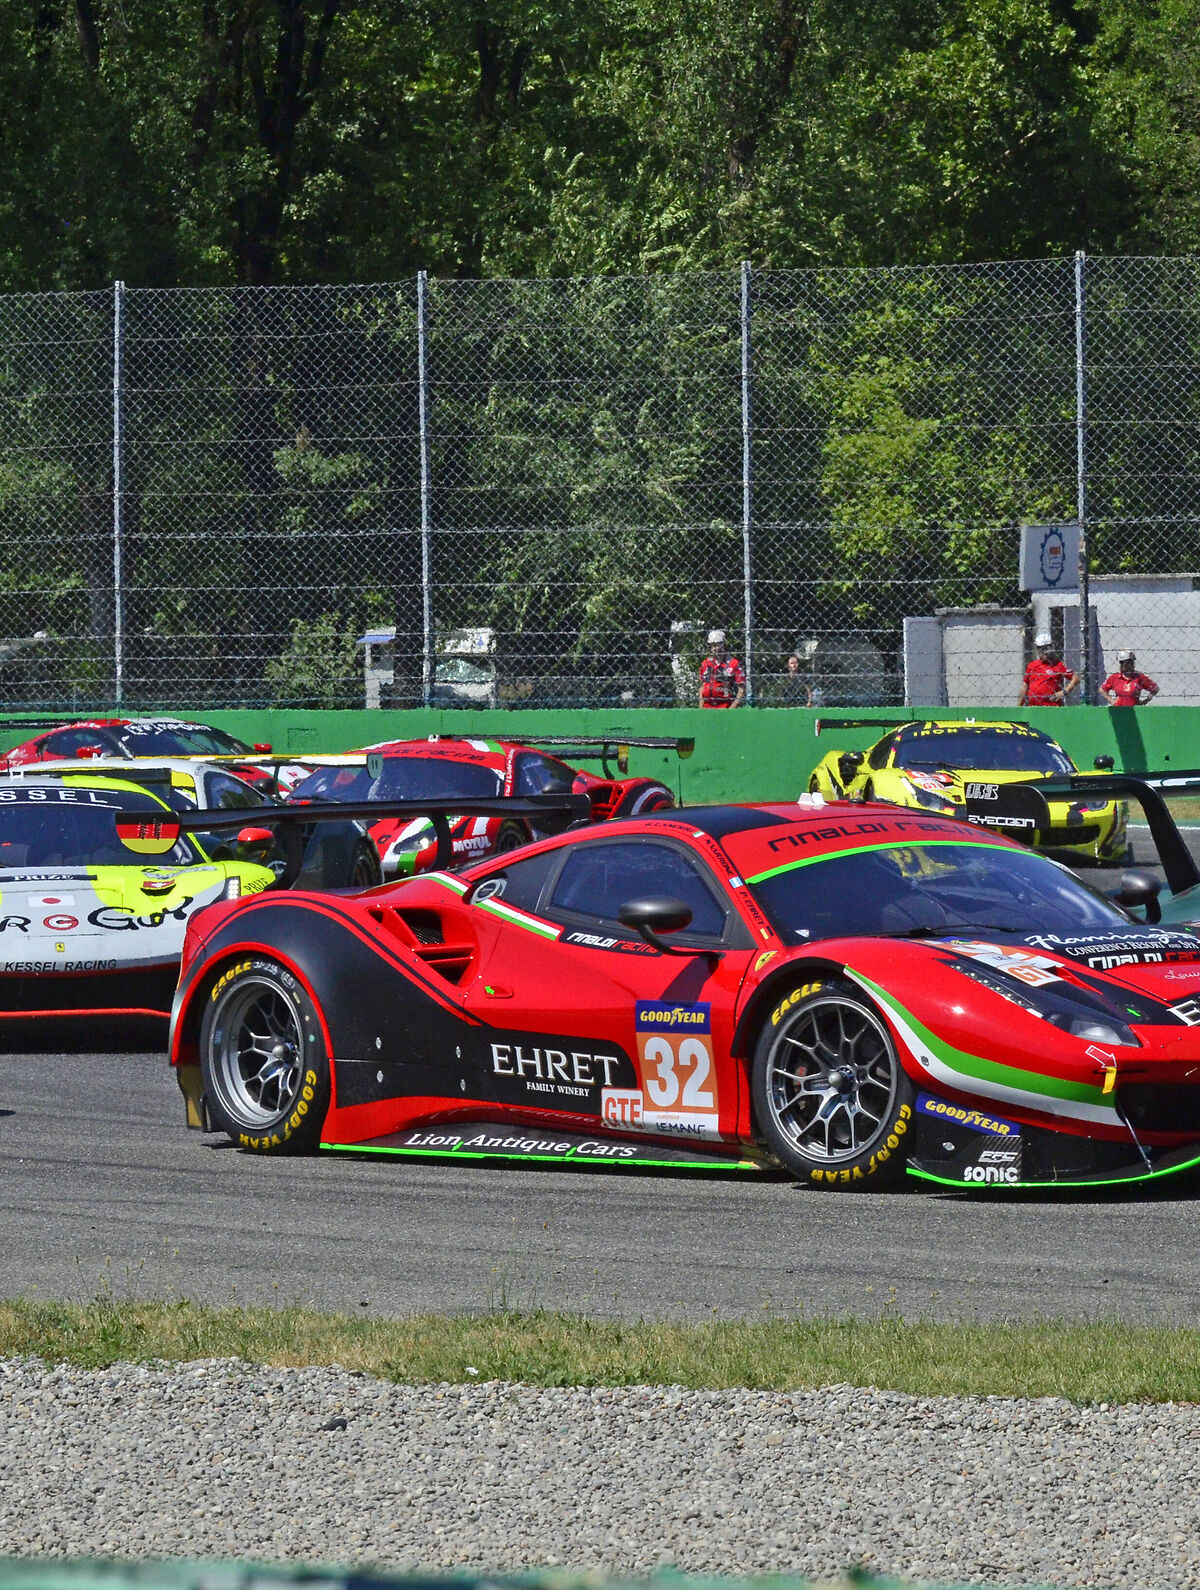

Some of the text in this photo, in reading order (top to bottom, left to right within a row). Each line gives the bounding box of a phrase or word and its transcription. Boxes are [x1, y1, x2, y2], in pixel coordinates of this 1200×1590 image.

[4, 958, 118, 973] KESSEL RACING
[1008, 965, 1052, 983] GT
[640, 1007, 706, 1026] GOODYEAR
[771, 982, 823, 1027] EAGLE
[489, 1043, 619, 1087] EHRET
[644, 1036, 715, 1109] 32
[526, 1081, 590, 1098] FAMILY WINERY
[604, 1096, 642, 1128] GTE
[924, 1099, 1011, 1136] GOODYEAR
[404, 1133, 638, 1158] Lion Antique Cars
